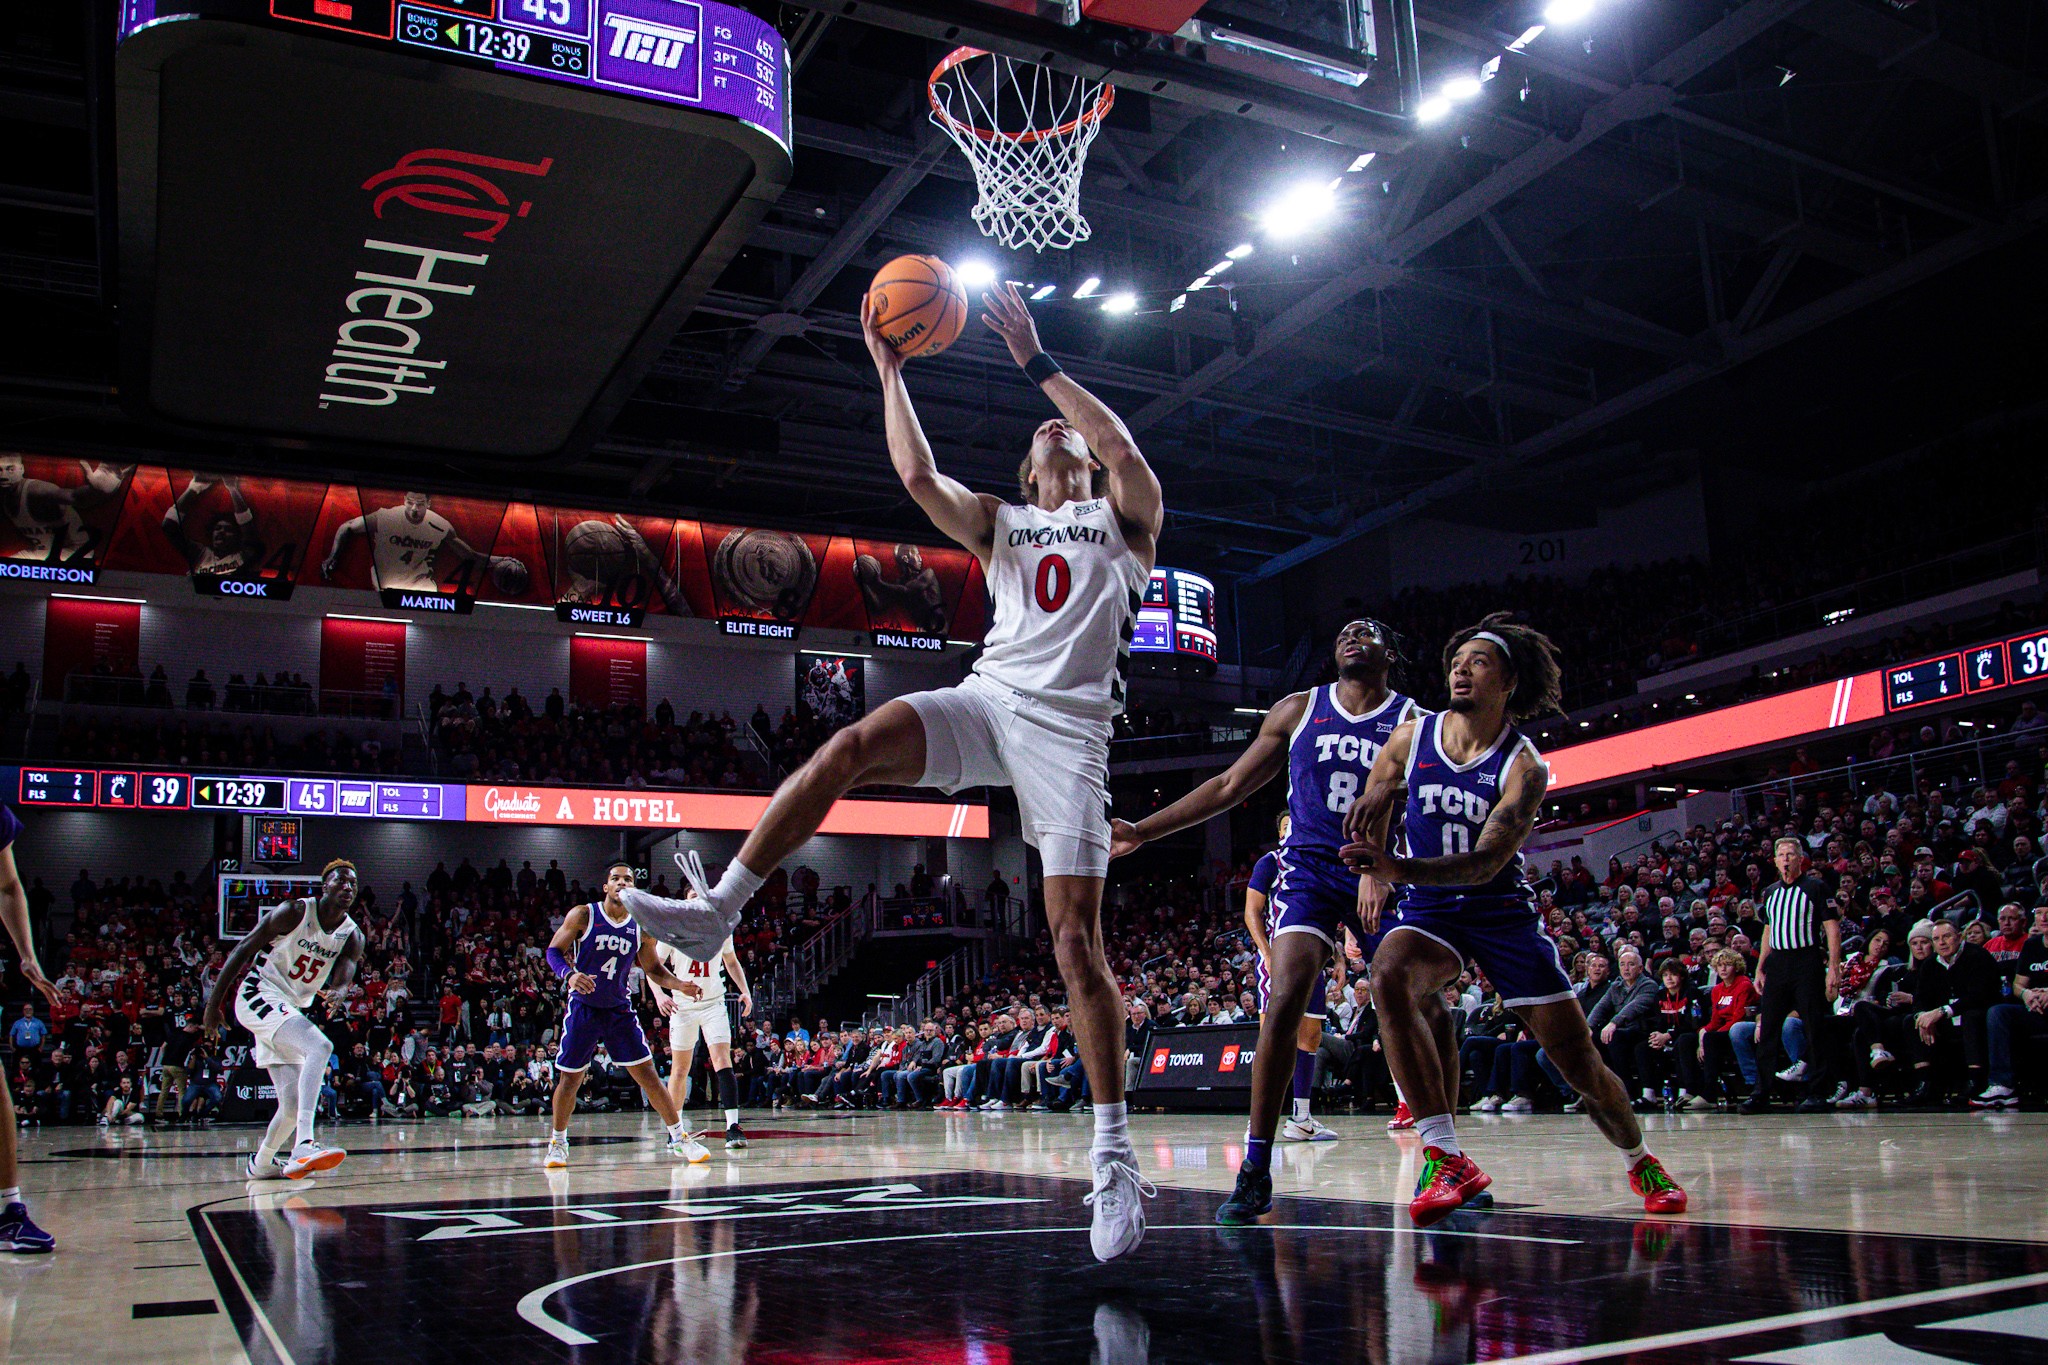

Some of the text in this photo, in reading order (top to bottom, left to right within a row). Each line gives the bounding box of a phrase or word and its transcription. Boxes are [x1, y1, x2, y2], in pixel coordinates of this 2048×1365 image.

[407, 13, 438, 27] BONUS
[465, 23, 531, 62] 12:39
[552, 42, 581, 56] BONUS
[603, 12, 697, 69] TCU
[714, 25, 775, 63] FG 45%
[713, 50, 738, 67] 3PT
[714, 75, 775, 111] FT 25%
[319, 238, 489, 406] Health
[1008, 524, 1108, 549] CINCINNATI
[1519, 538, 1566, 564] 201
[0, 563, 94, 584] ROBERTSON
[1035, 553, 1072, 614] 0
[220, 580, 268, 597] COOK
[401, 594, 455, 611] MARTIN
[571, 608, 631, 625] SWEET 16
[726, 621, 794, 638] ELITE EIGHT
[876, 634, 941, 650] FINAL FOUR
[1893, 661, 1946, 685] TOL 2
[1896, 680, 1948, 704] FLS 4
[1315, 734, 1383, 770] TCU
[28, 773, 82, 786] TOL 2
[152, 778, 180, 804] 39
[28, 790, 81, 801] FLS 4
[215, 781, 266, 806] 12:39
[298, 784, 325, 809] 45
[382, 788, 429, 799] TOL 3
[484, 788, 541, 819] Graduate
[1327, 770, 1358, 814] 8
[1418, 784, 1490, 824] TCU
[383, 803, 428, 814] FLS 4
[556, 796, 681, 823] A HOTEL
[595, 934, 632, 956] TCU
[288, 954, 325, 984] 55
[600, 956, 618, 980] 4
[688, 959, 710, 978] 41
[174, 1014, 187, 1028] 18
[1169, 1053, 1204, 1066] TOYOTA
